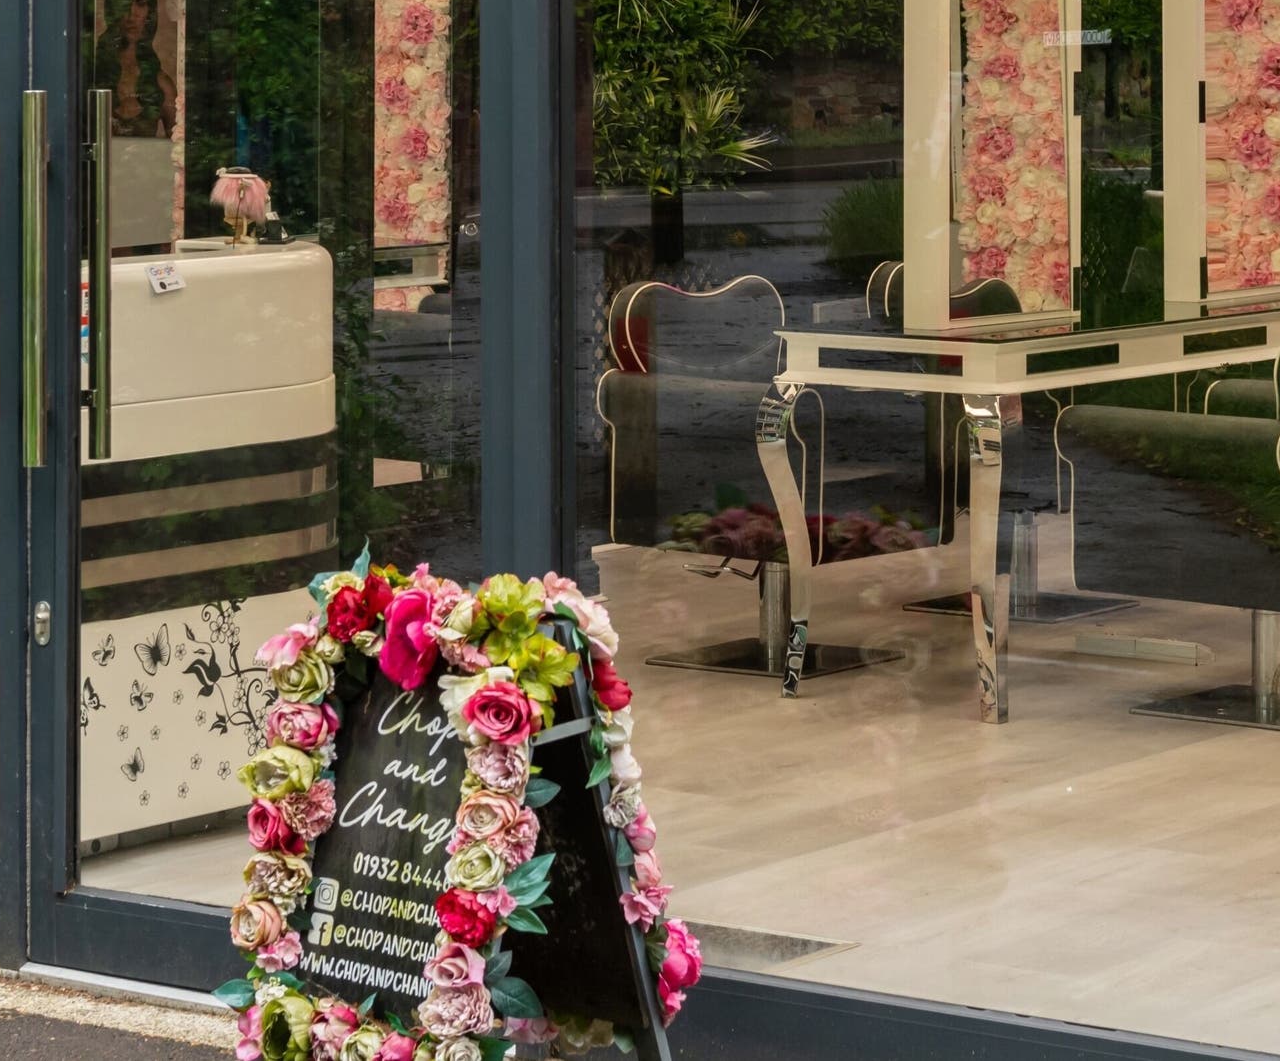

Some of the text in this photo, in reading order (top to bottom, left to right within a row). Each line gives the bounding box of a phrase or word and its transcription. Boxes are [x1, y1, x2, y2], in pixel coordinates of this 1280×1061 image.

[377, 691, 458, 756] Chop
[383, 757, 448, 787] and
[333, 924, 438, 963] @CHOPANDCHA
